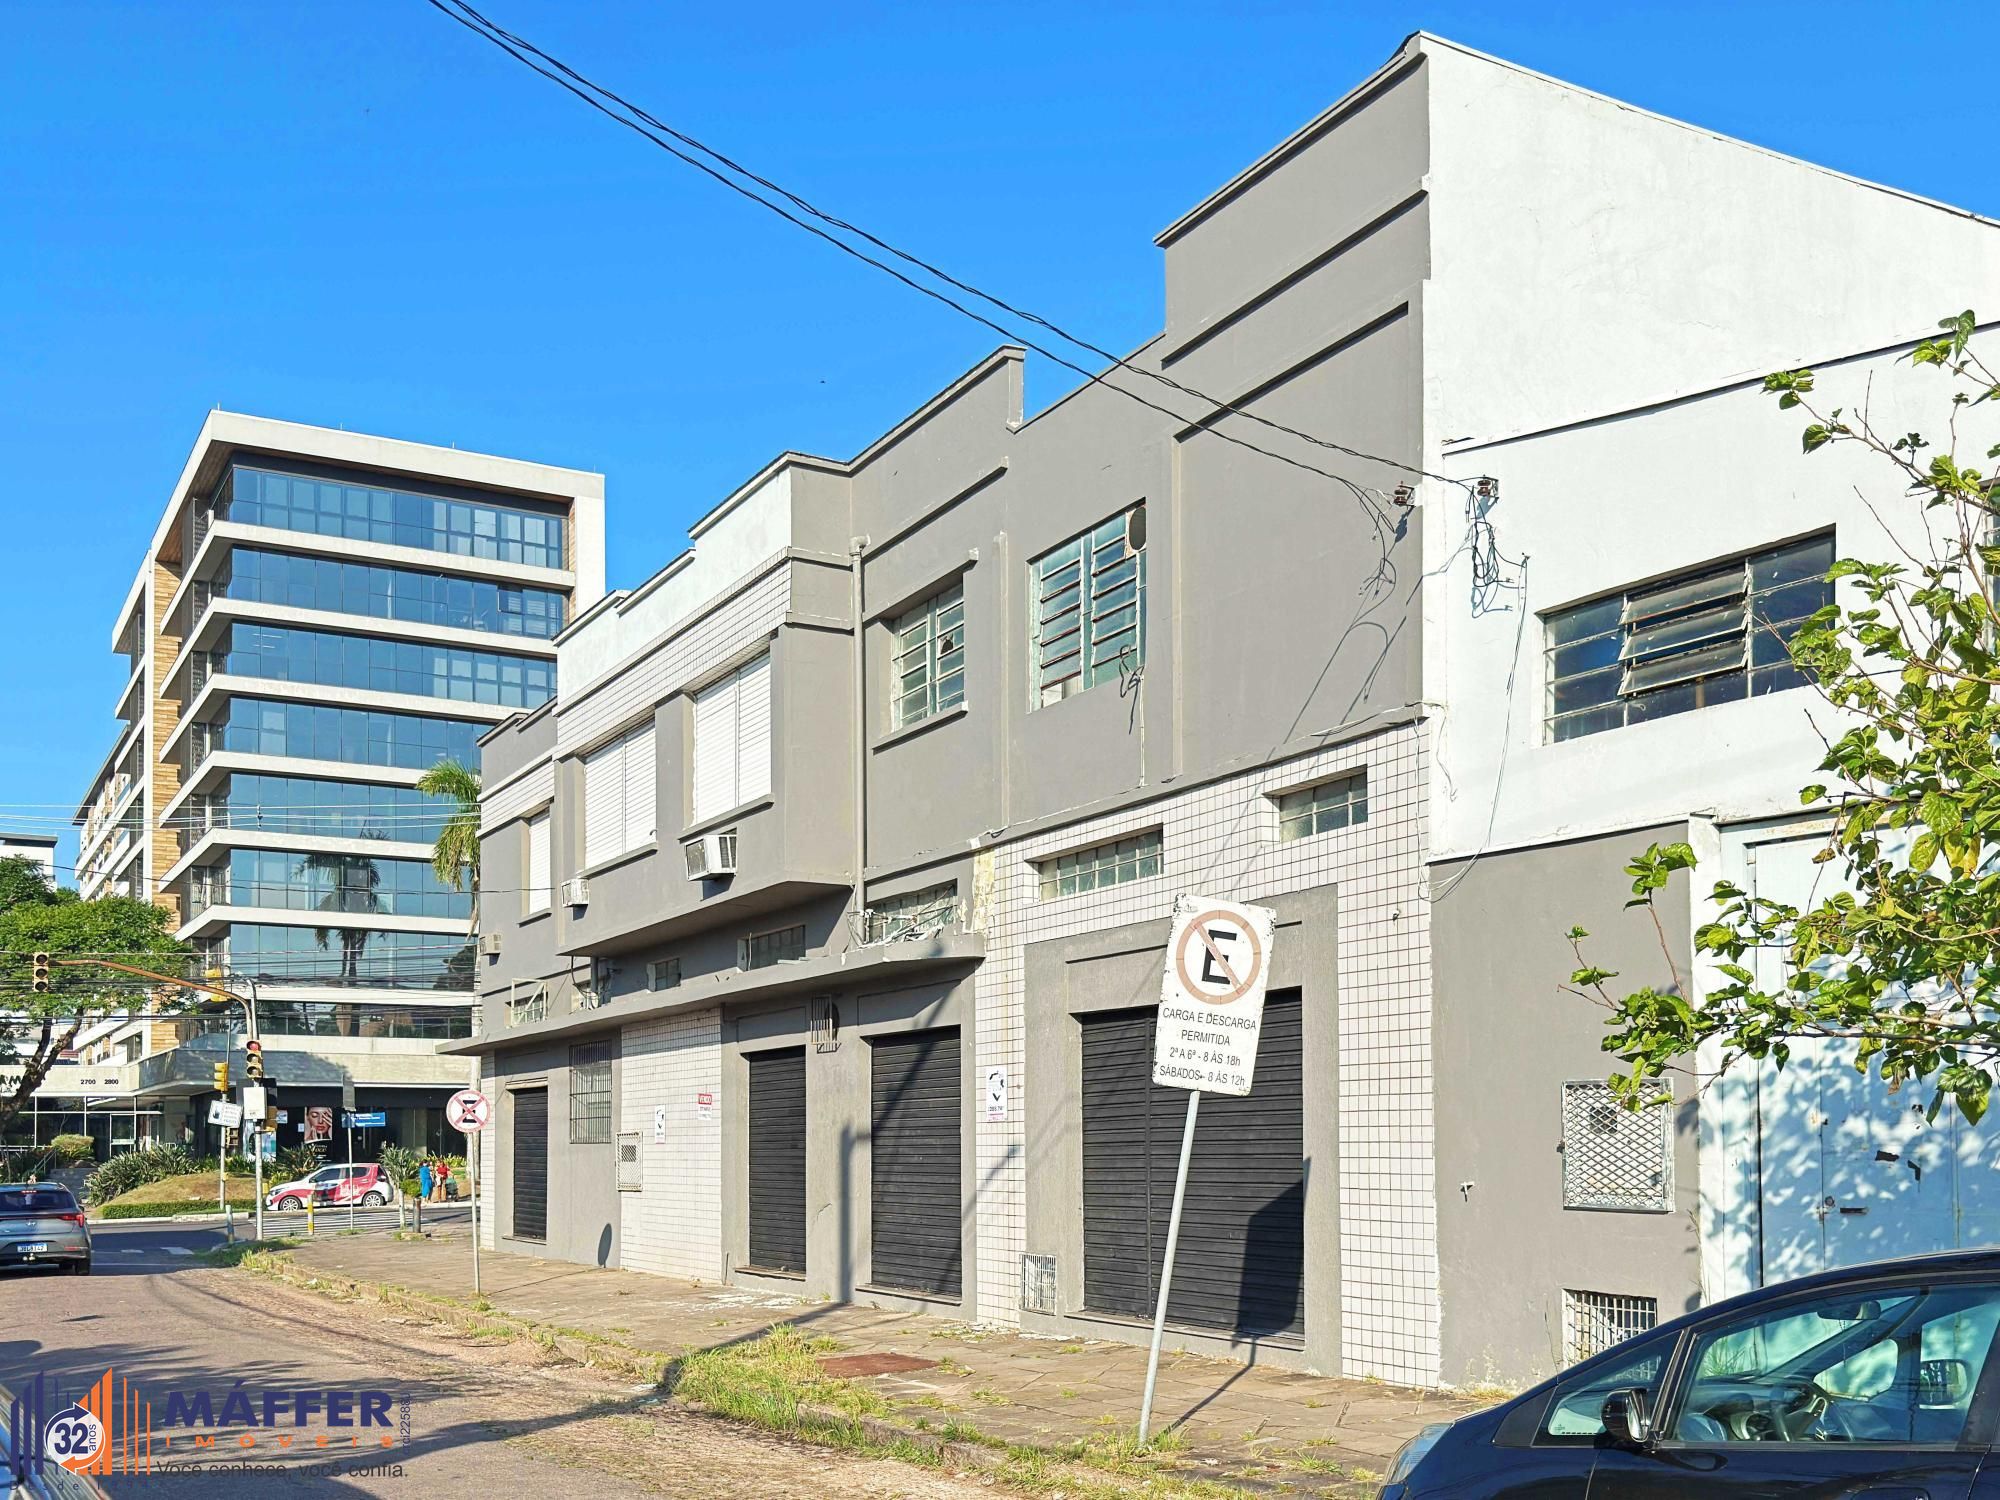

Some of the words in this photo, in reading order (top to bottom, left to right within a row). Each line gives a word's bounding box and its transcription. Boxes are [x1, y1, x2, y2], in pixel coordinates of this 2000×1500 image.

[1163, 1007, 1195, 1021] CARGA
[1197, 1012, 1204, 1023] E
[1205, 1013, 1256, 1030] DESCARGA
[1181, 1029, 1230, 1046] PERMITIDA
[1178, 1048, 1186, 1059] A
[1203, 1051, 1209, 1062] 8
[1226, 1055, 1241, 1067] 18h
[1207, 1071, 1214, 1082] 8
[1231, 1074, 1246, 1087] 12h
